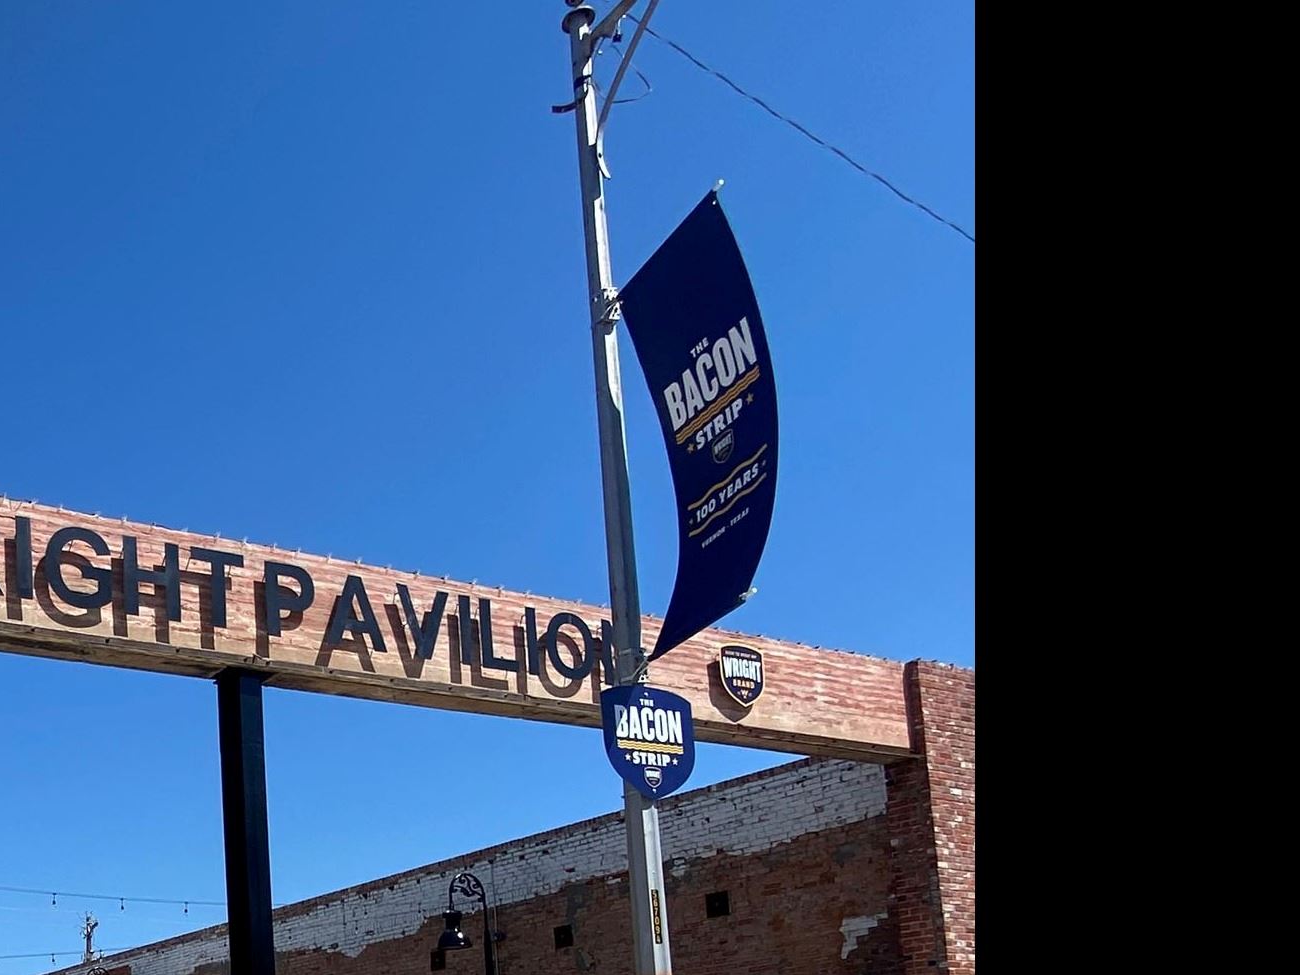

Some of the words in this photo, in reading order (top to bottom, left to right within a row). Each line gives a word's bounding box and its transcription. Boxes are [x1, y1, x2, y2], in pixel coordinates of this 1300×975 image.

[689, 337, 710, 358] THE
[663, 316, 757, 432] BACON
[695, 398, 743, 450] STRIP
[695, 498, 717, 523] 100
[718, 462, 759, 504] YEARS
[722, 656, 761, 683] WRIGHT
[639, 698, 654, 707] THE
[614, 704, 684, 744] BACON
[632, 751, 671, 767] STRIP
